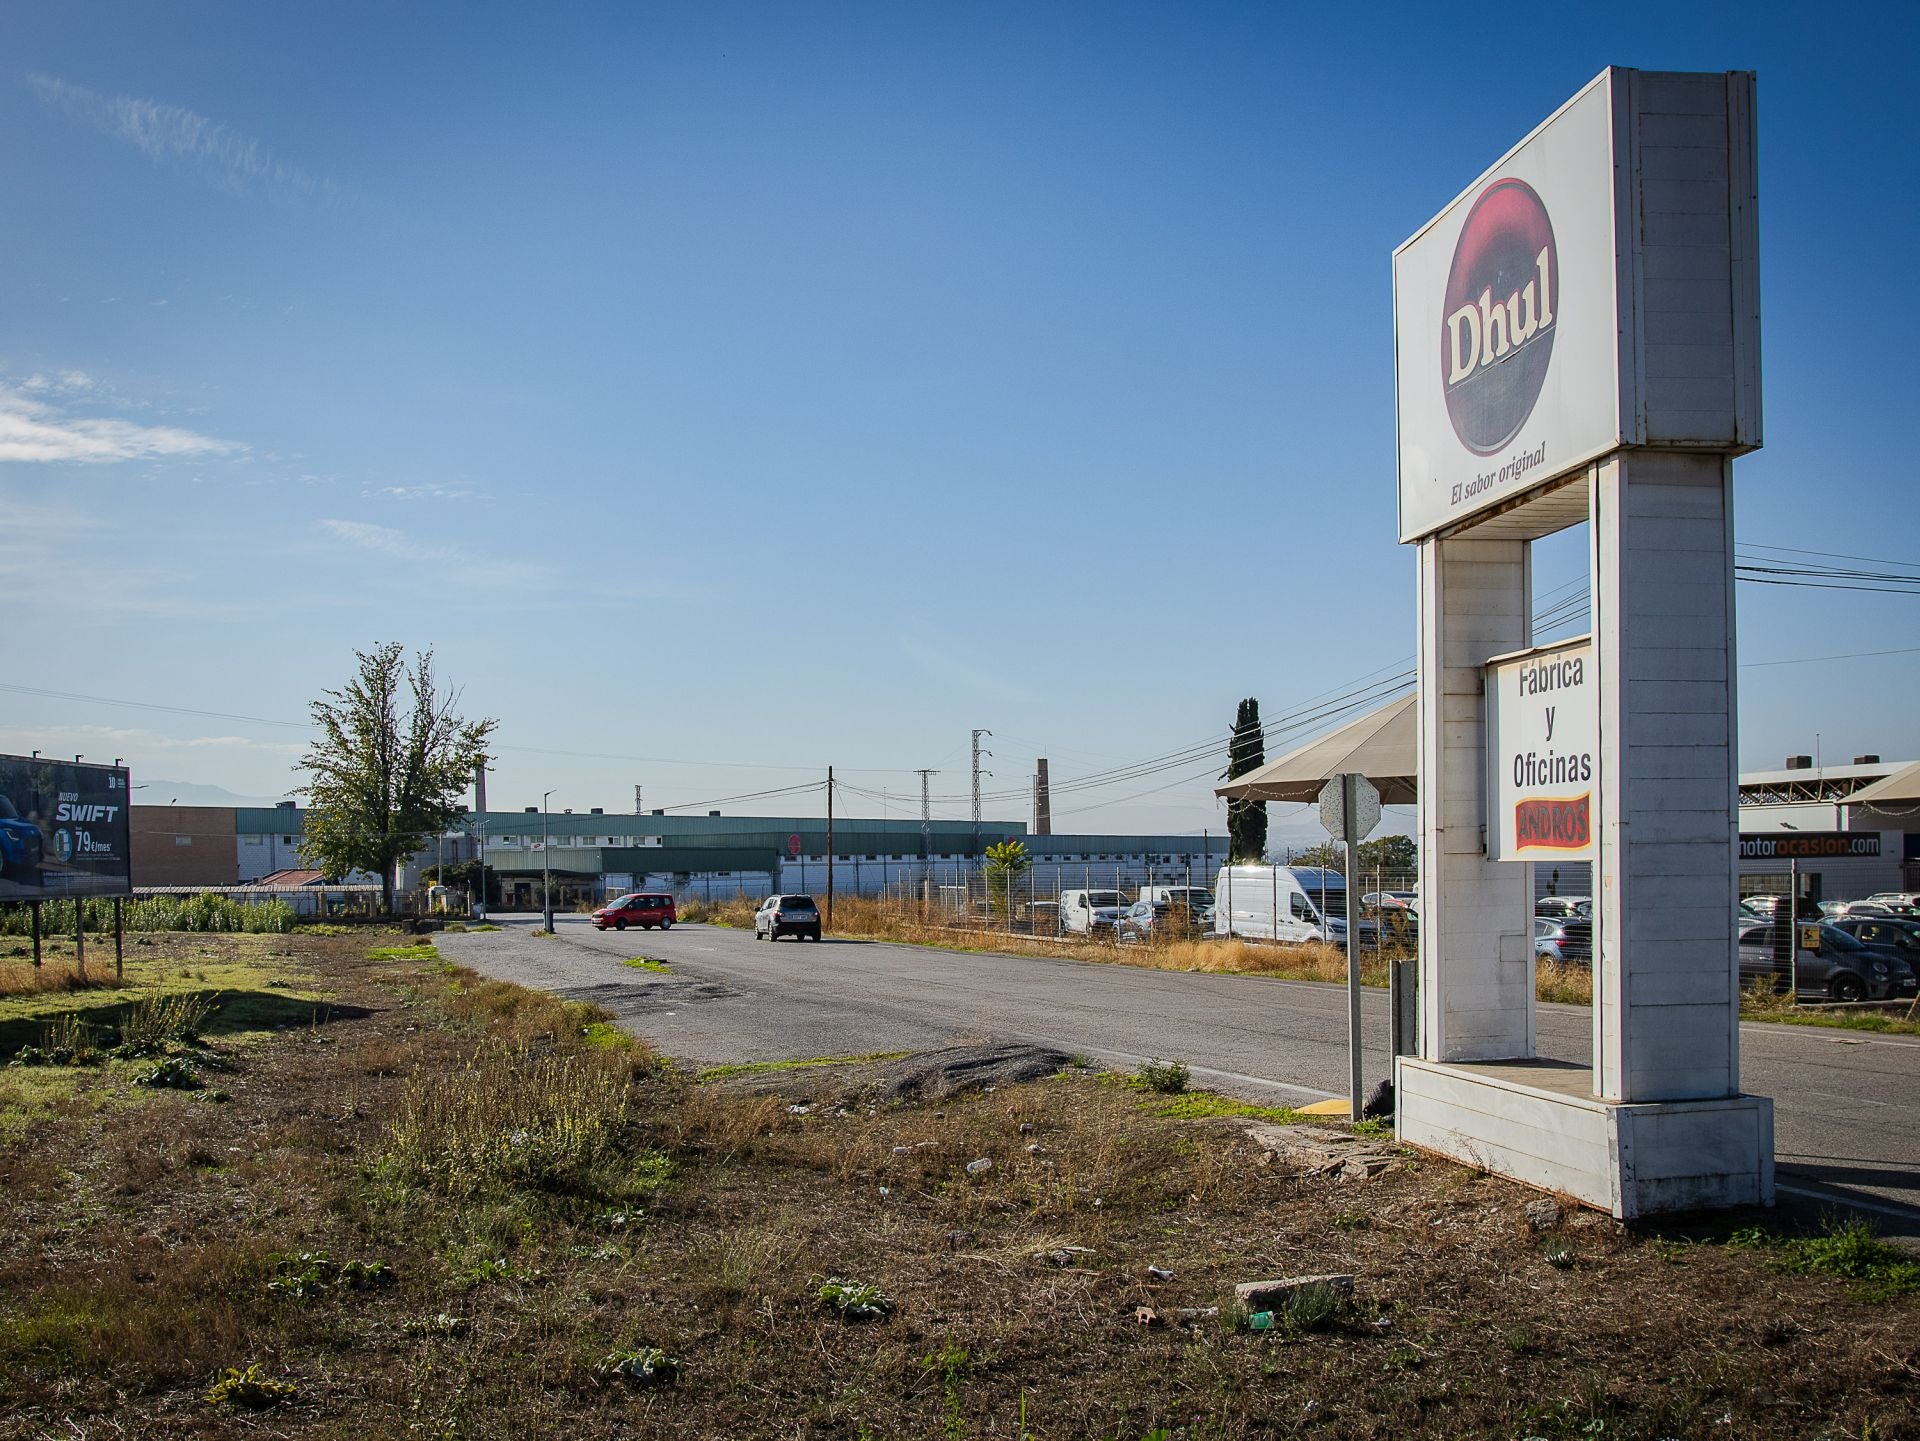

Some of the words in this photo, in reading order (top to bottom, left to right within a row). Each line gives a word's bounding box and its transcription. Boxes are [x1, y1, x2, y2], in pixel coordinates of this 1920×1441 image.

[1447, 245, 1553, 386] Dhul
[1450, 481, 1463, 506] El
[1464, 473, 1497, 500] sabor
[1498, 440, 1546, 481] original
[1519, 654, 1584, 697] Fábrica
[1545, 706, 1556, 742] y
[1513, 749, 1592, 788] Oficinas
[56, 803, 118, 823] SWIFT
[58, 792, 78, 802] NUEVO
[1519, 804, 1589, 842] ANDROS
